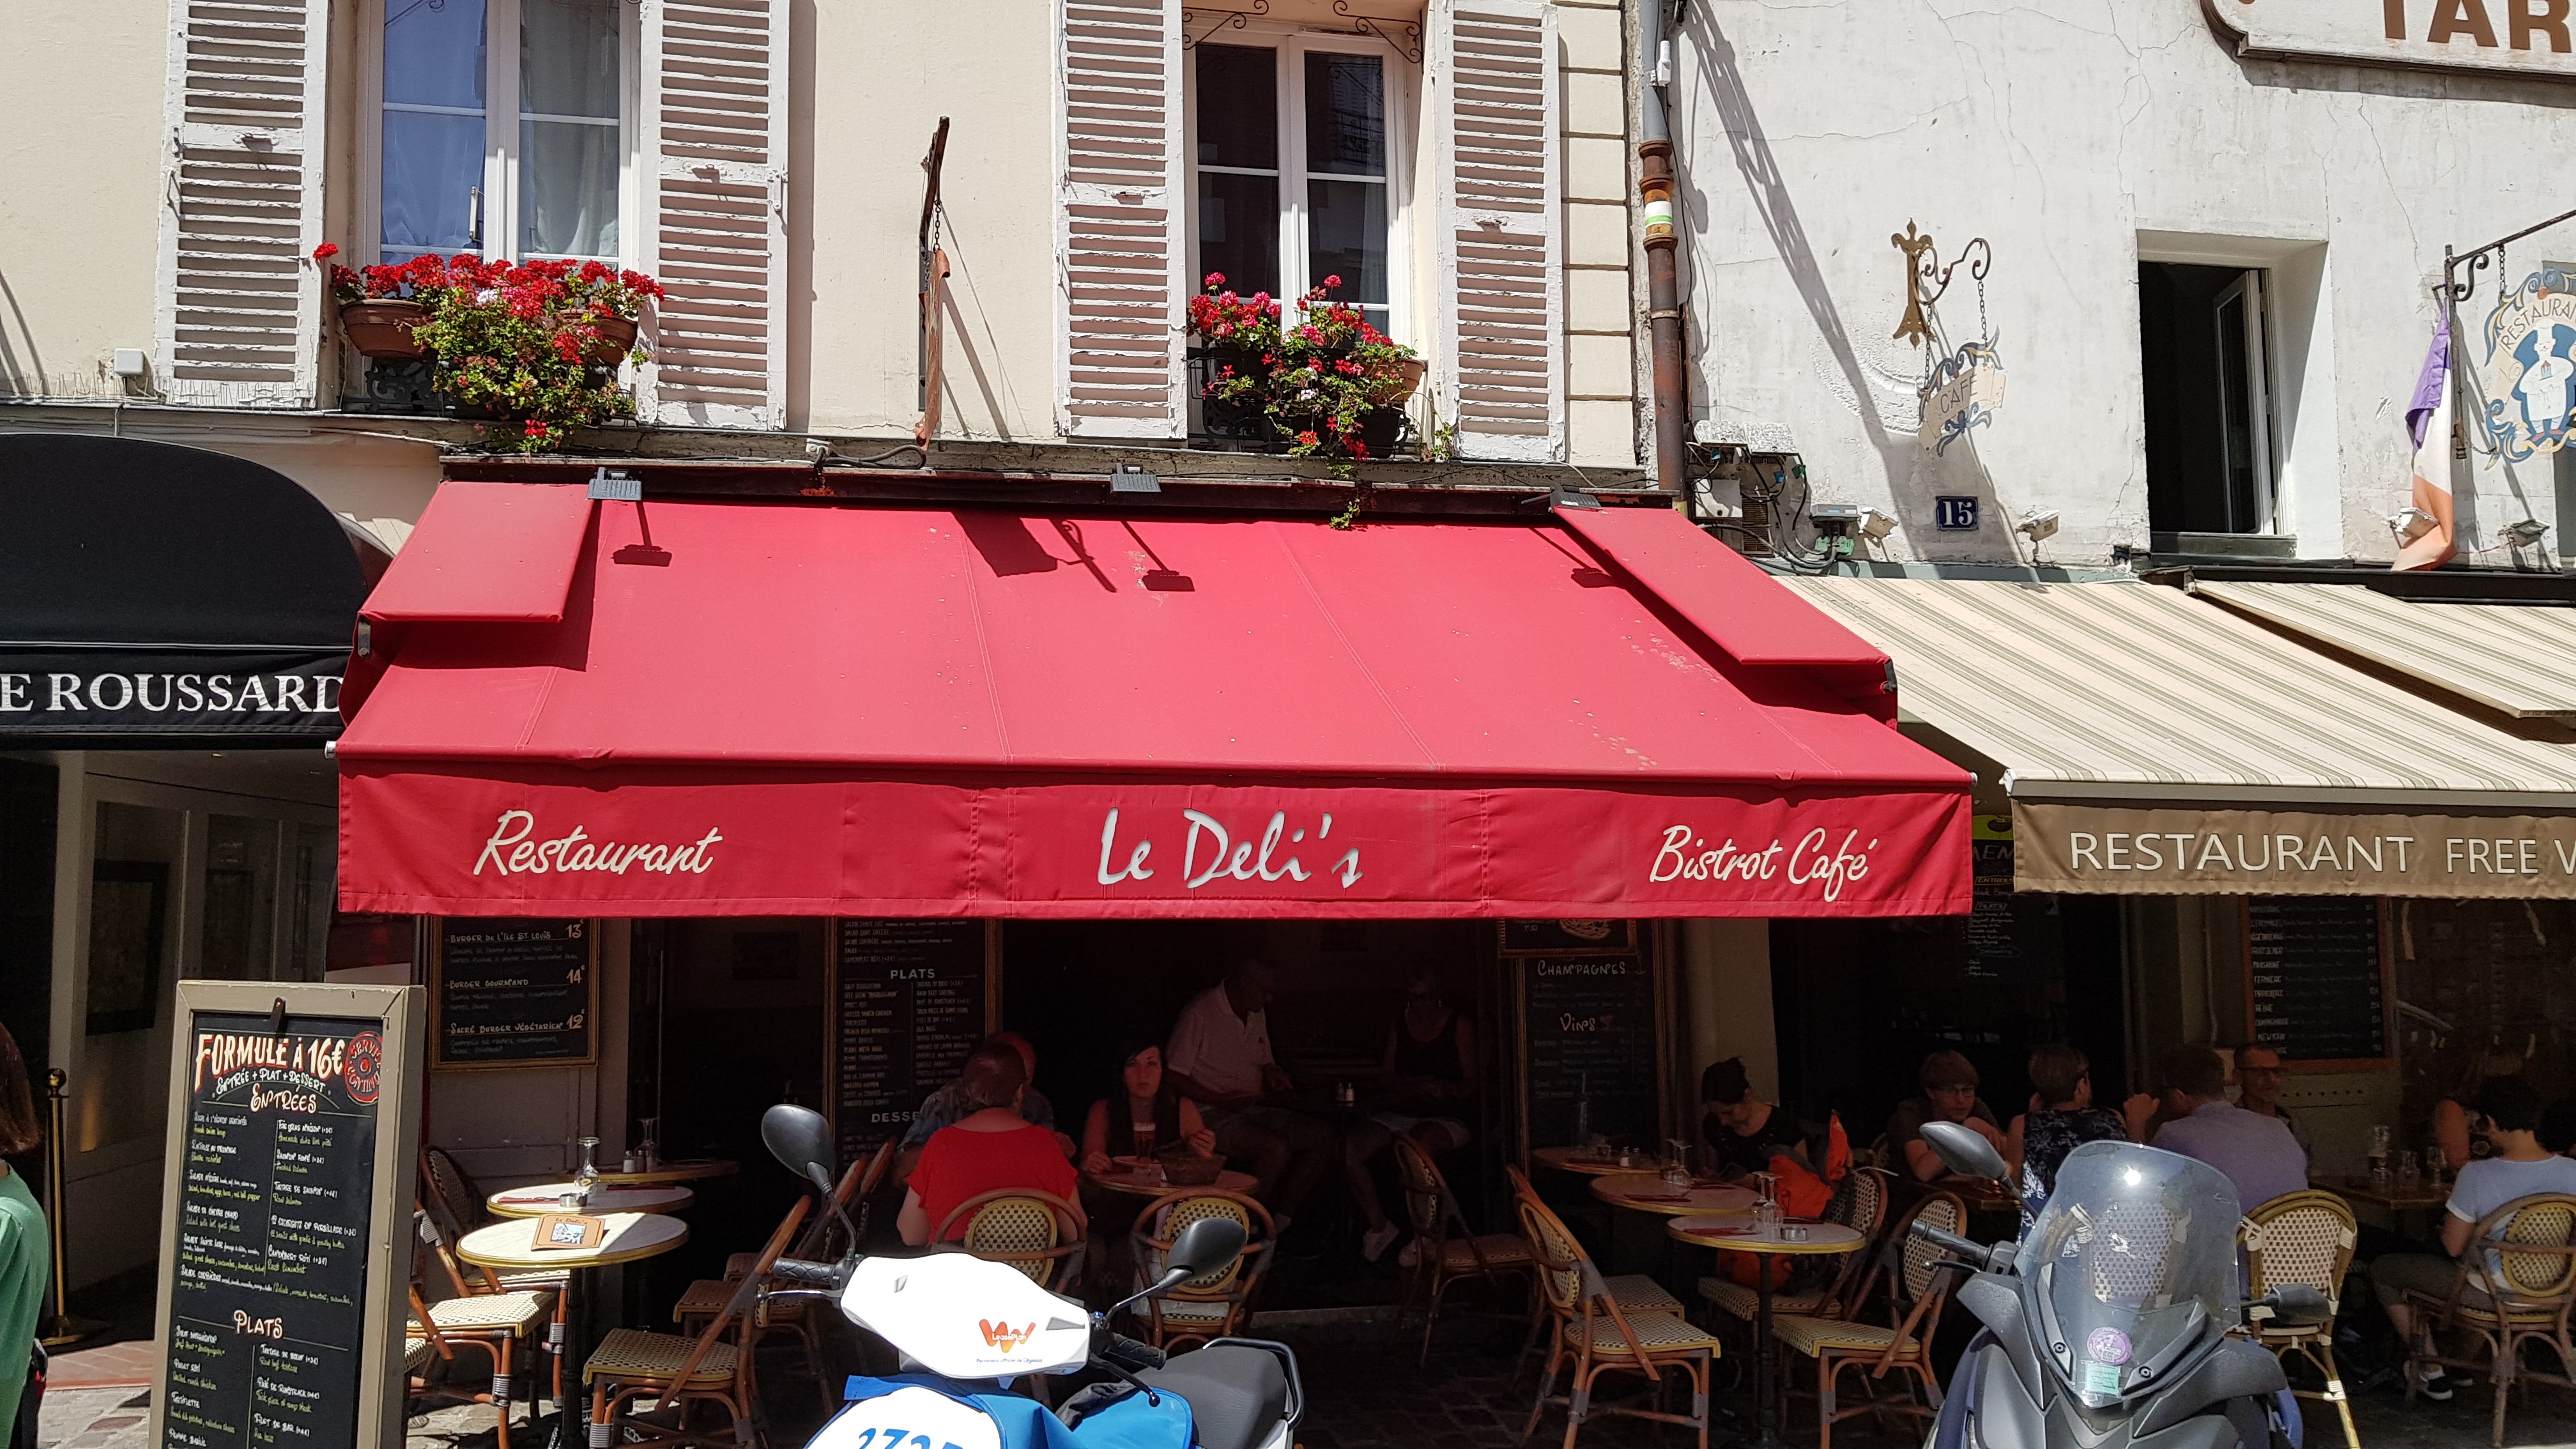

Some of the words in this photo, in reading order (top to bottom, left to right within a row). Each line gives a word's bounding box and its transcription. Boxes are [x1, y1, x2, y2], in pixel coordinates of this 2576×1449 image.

[1943, 500, 1974, 526] 15
[45, 672, 344, 712] ROUSSARD
[473, 809, 723, 876] Restaurant
[1097, 806, 1155, 885] Le
[1183, 808, 1364, 889] Deli's
[2069, 832, 2415, 873] RESTAURANT
[2445, 838, 2540, 874] FREE
[1649, 824, 1783, 883] Bistrot
[1788, 827, 1878, 903] Café
[890, 969, 935, 979] PLATS
[1537, 960, 1626, 976] CHAMPAGNES
[194, 1033, 290, 1093] FORMULE
[307, 1038, 346, 1081] 16€
[215, 1068, 250, 1095] ENTRÉE
[260, 1068, 282, 1082] PLAT
[289, 1071, 326, 1094] DESSERT
[250, 1084, 318, 1114] ENTRÉES
[233, 1310, 283, 1340] PLATS
